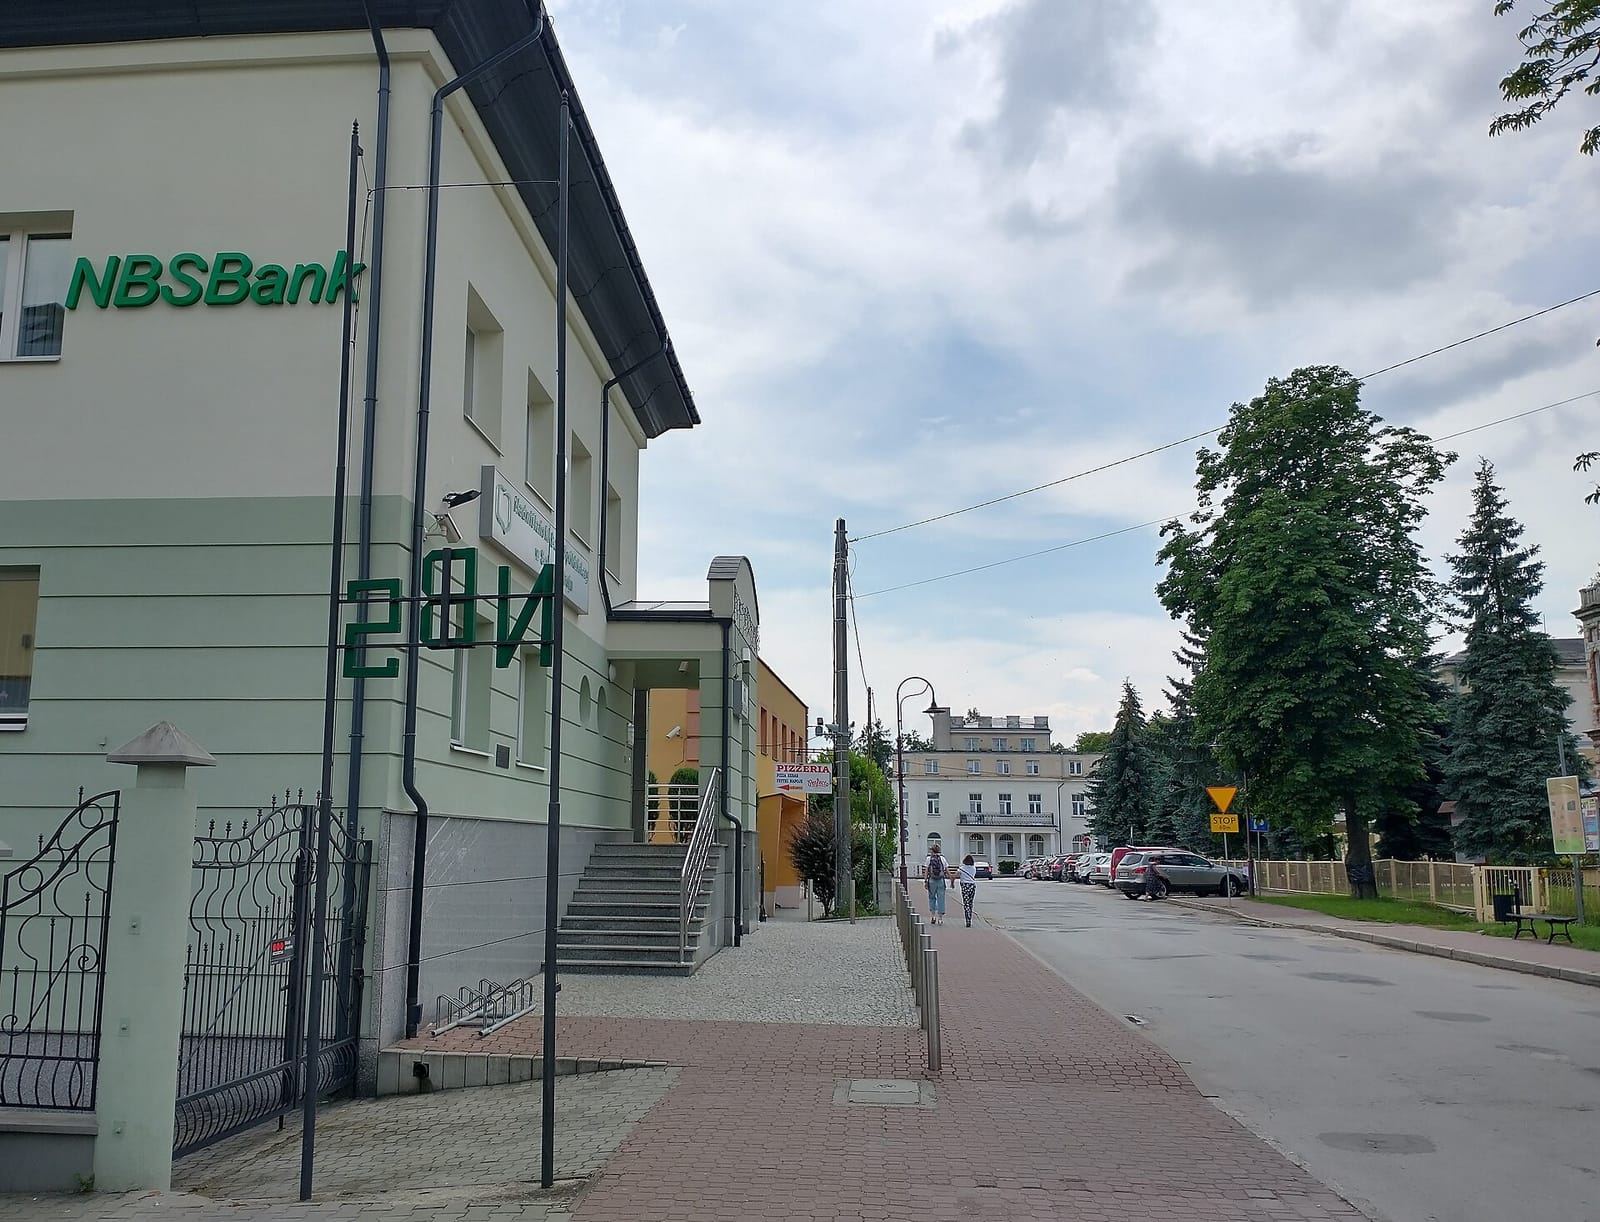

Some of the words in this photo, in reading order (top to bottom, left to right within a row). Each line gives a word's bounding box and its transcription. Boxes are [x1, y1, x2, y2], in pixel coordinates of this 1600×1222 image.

[65, 250, 367, 311] NBSBank
[777, 765, 830, 773] PIZZERIA
[1213, 816, 1236, 825] STOP
